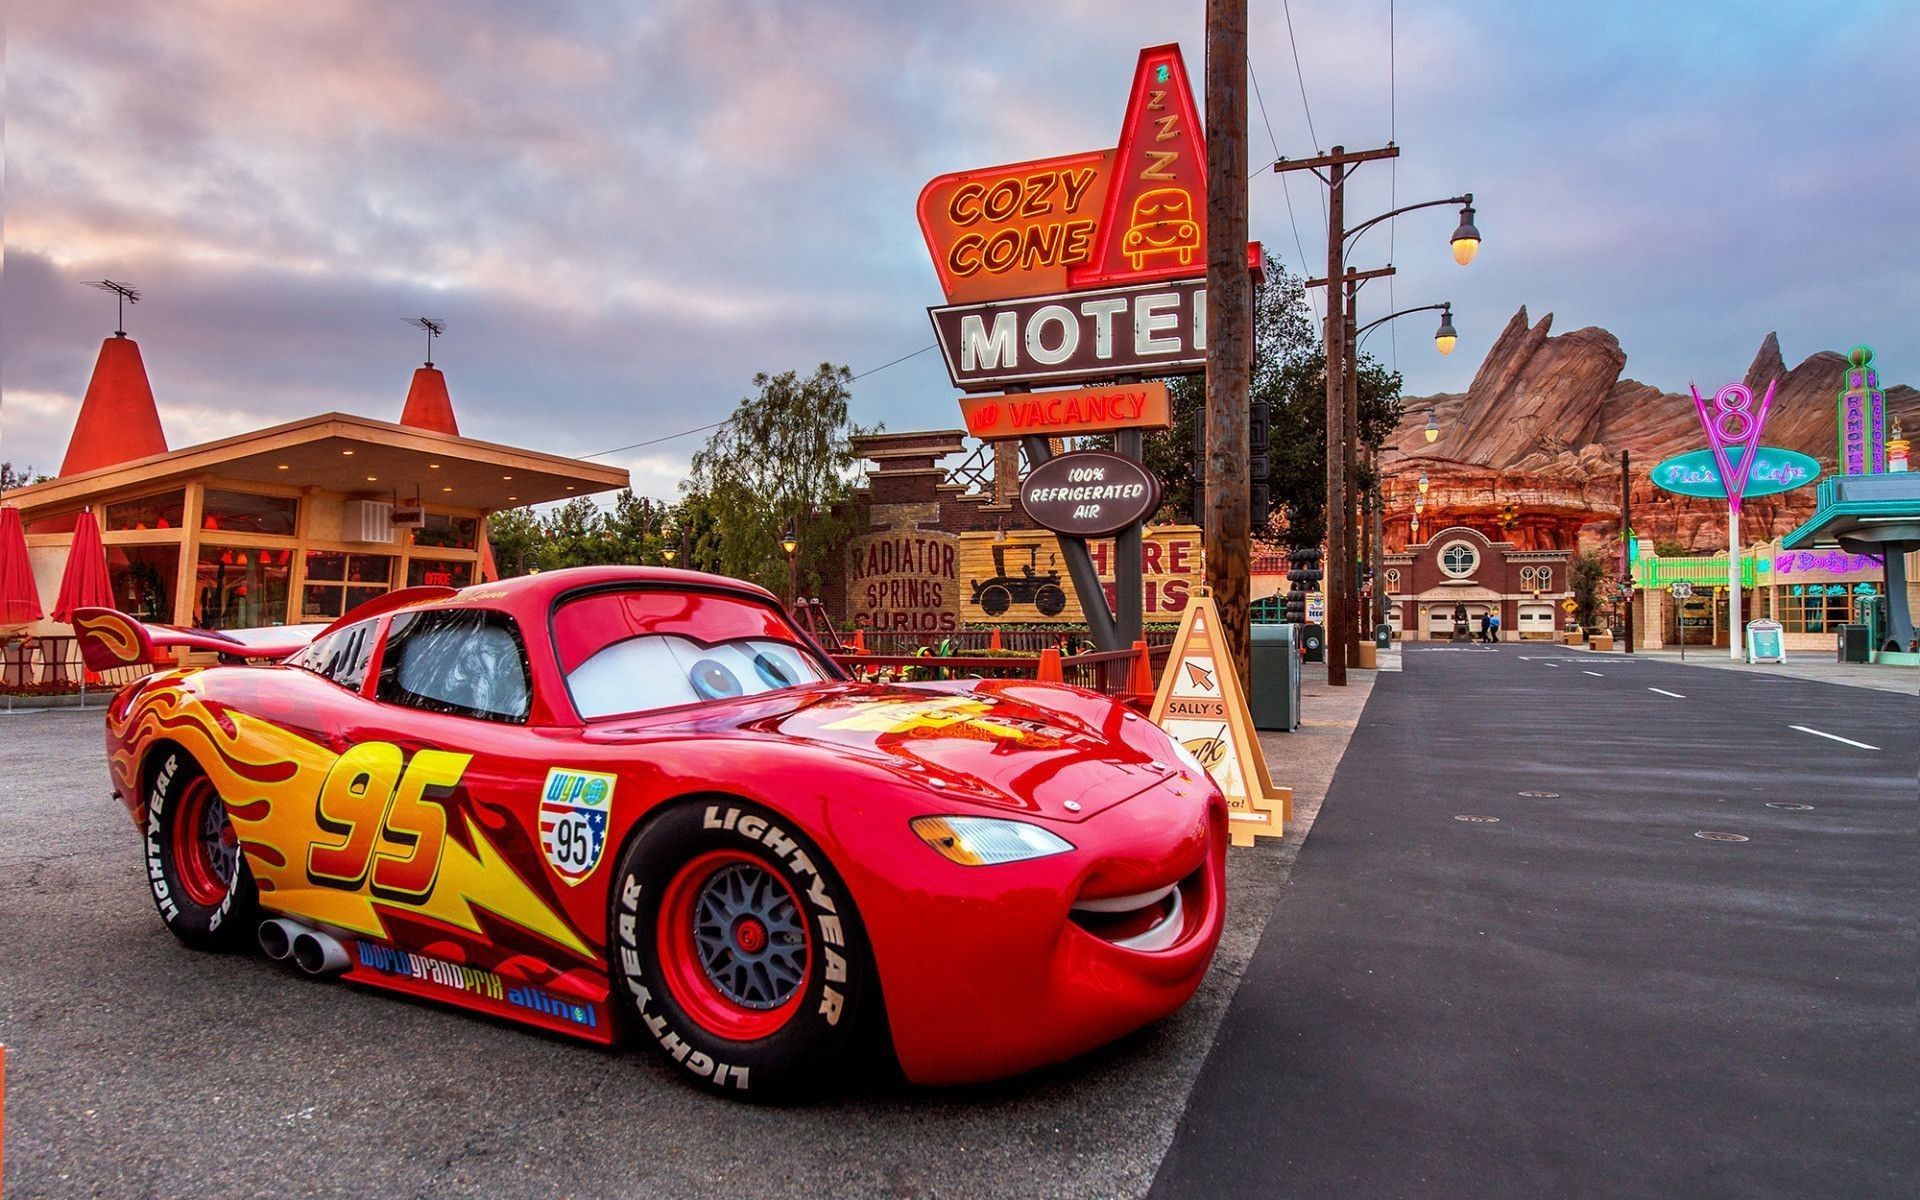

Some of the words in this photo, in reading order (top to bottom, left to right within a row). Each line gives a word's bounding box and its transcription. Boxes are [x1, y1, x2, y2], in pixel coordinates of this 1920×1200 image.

[948, 168, 1097, 226] COZY
[948, 220, 1096, 276] CONE
[971, 403, 997, 429] NO
[1009, 392, 1147, 428] VACANCY
[1030, 484, 1144, 503] REFRIGERATED
[1068, 467, 1104, 483] 100%
[1073, 504, 1100, 519] AIR
[852, 538, 955, 581] RADIATOR
[1086, 541, 1192, 575] HRE
[867, 578, 942, 609] SPRINGS
[1145, 579, 1190, 613] IS
[855, 611, 956, 631] CURIOS
[1168, 702, 1224, 715] SALLY'S
[148, 754, 180, 922] LIGHTYEAR
[306, 741, 471, 906] 95
[557, 819, 587, 866] 95
[703, 805, 847, 1026] LIGHTYEAR
[619, 873, 750, 1089] LIGHTYEAR
